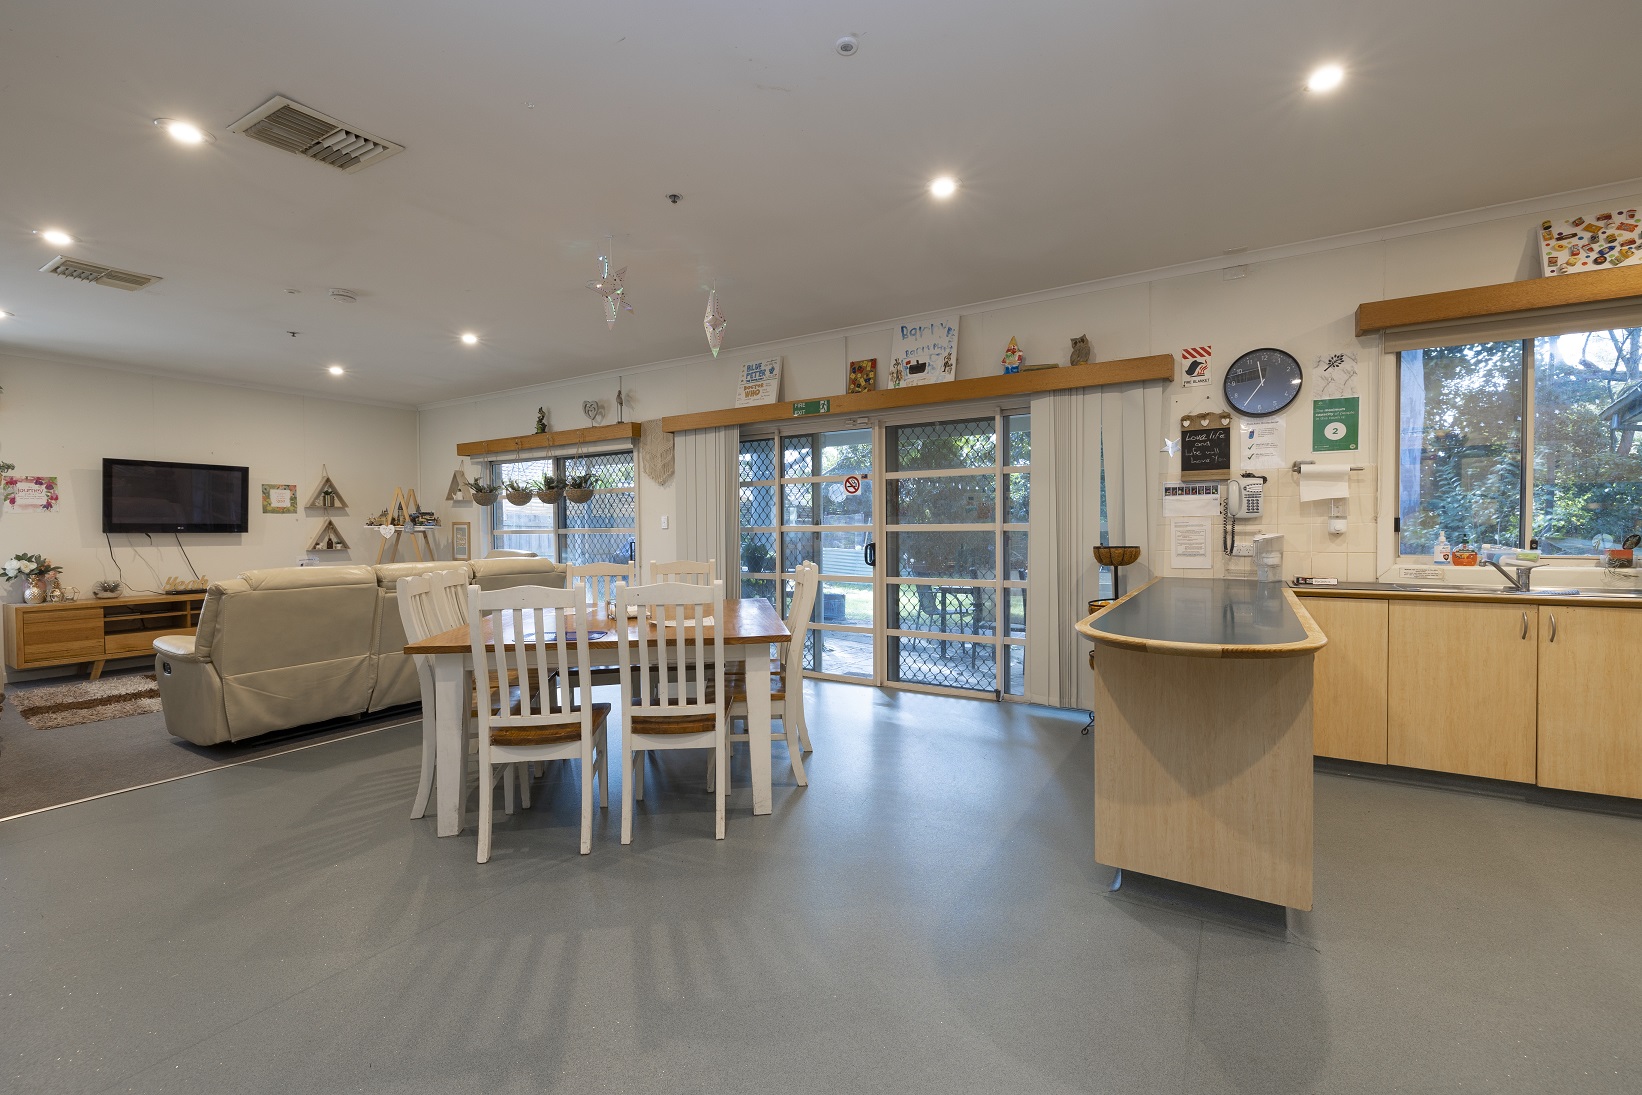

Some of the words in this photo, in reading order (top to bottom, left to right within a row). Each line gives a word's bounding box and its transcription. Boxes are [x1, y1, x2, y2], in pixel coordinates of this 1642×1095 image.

[746, 362, 763, 373] BLUE
[745, 369, 767, 379] PETER
[743, 383, 765, 391] DOCTOR
[744, 389, 761, 398] WHO
[1332, 427, 1339, 435] 2
